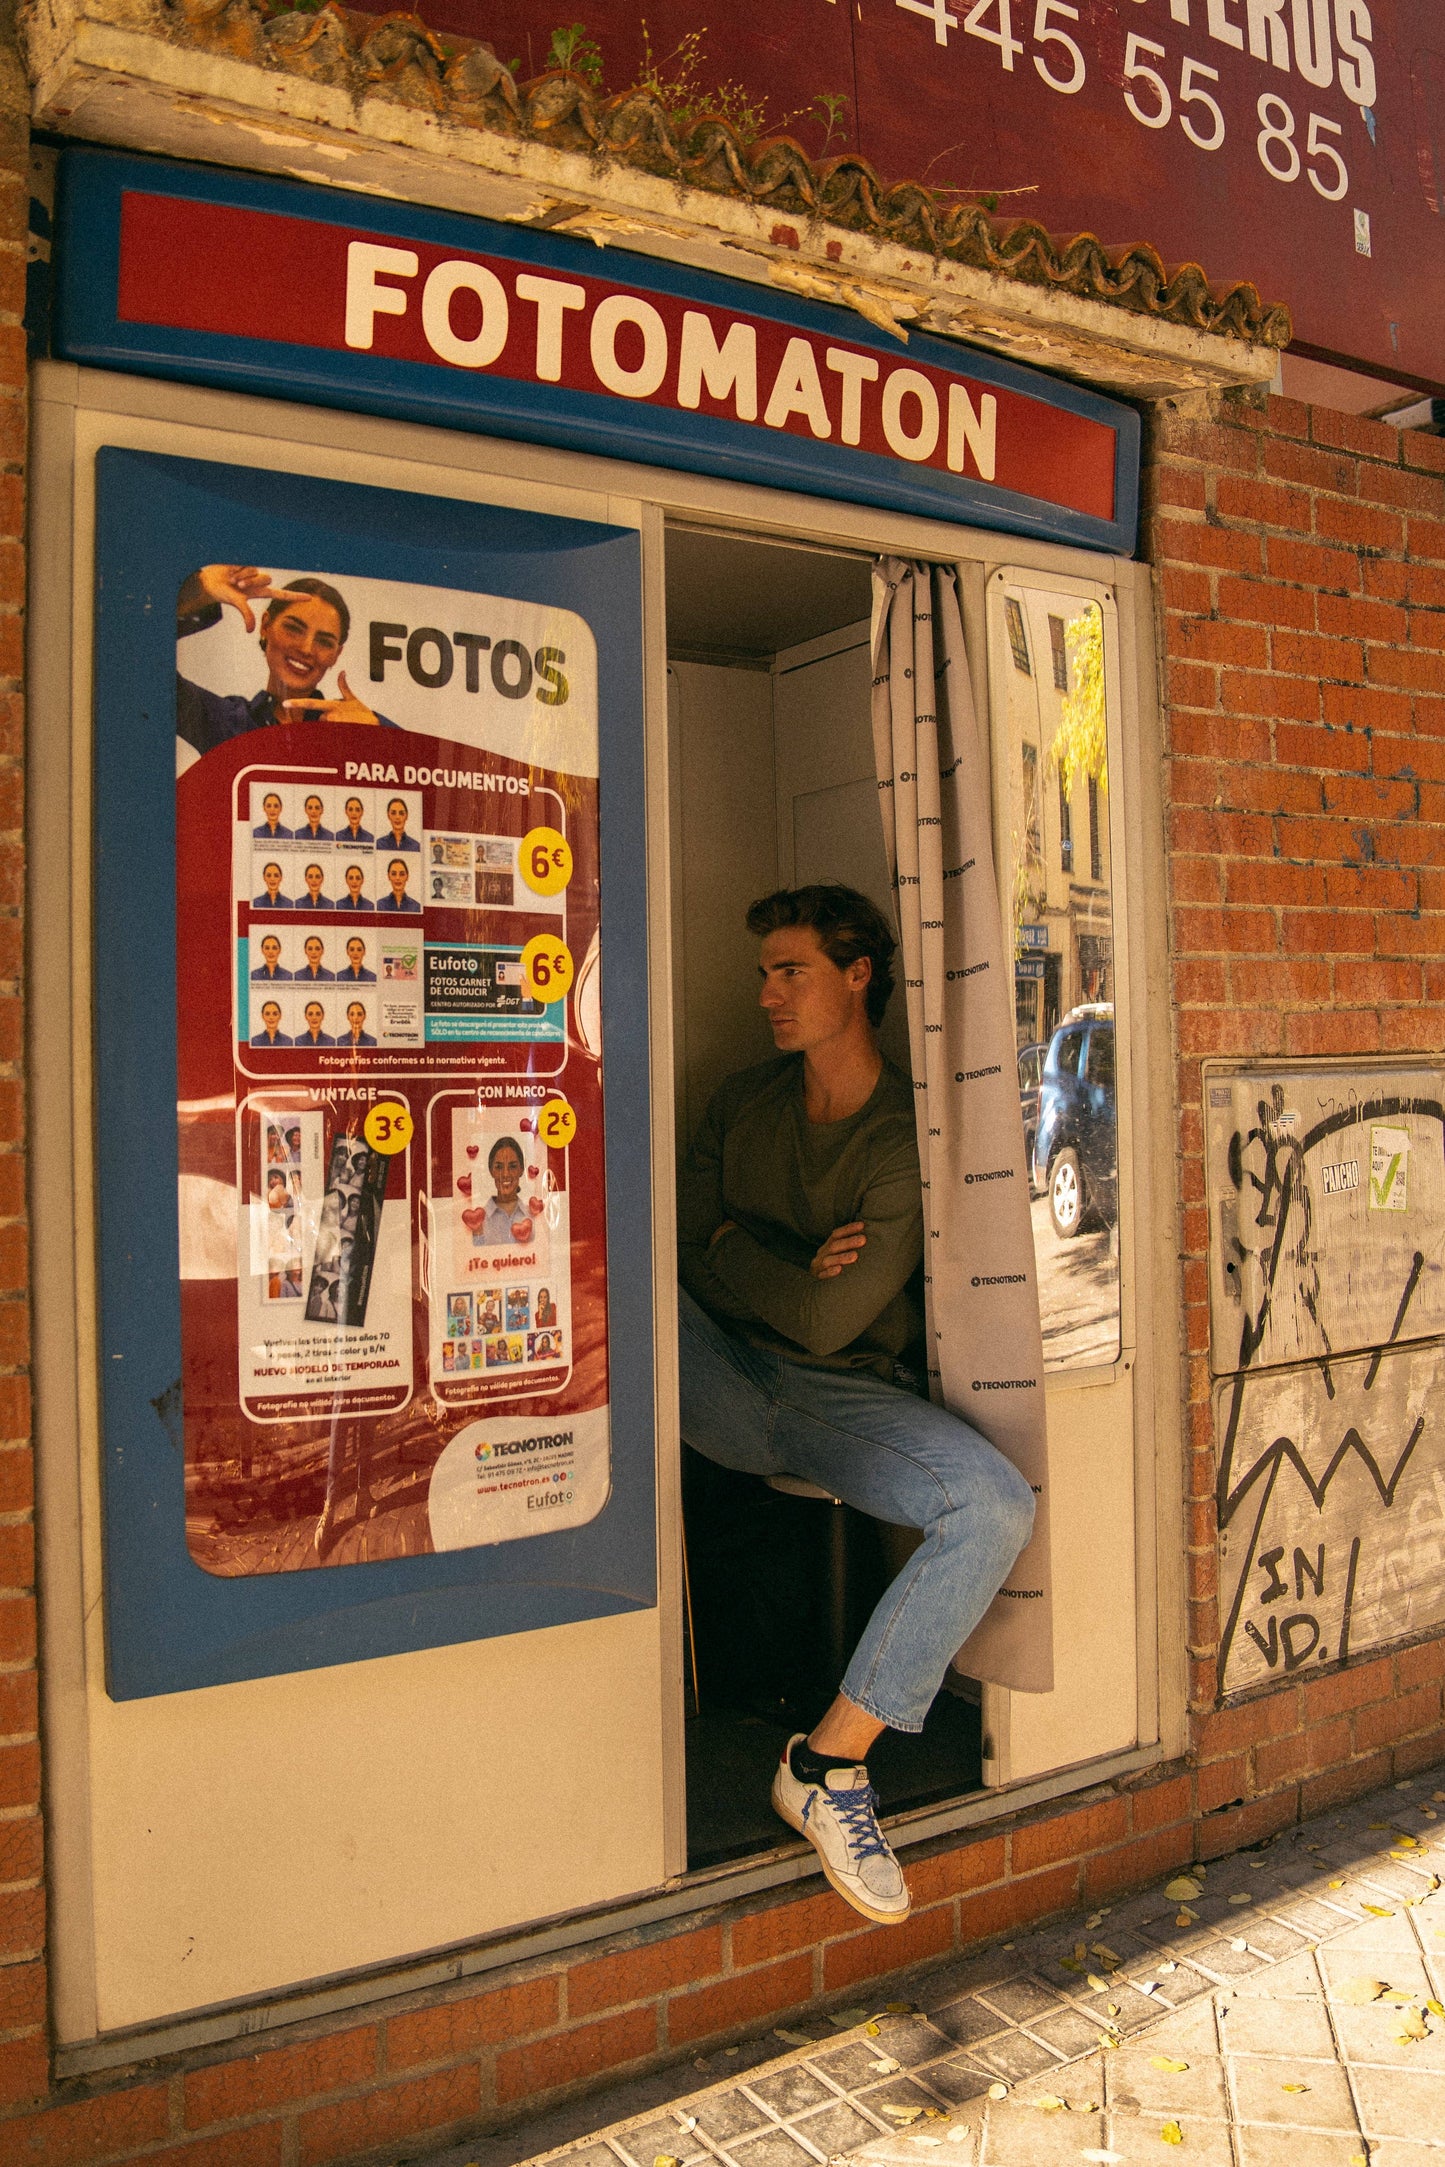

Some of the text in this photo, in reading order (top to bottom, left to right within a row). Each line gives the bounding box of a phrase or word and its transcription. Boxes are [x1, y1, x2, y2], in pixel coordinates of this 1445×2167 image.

[1123, 31, 1225, 151] 55
[1257, 92, 1348, 201] 85
[345, 241, 997, 482] FOTOMATON
[369, 621, 570, 706] FOTOS
[345, 761, 530, 796] PARA DOCUMENTOS
[531, 845, 564, 878] 6€
[430, 956, 478, 972] Eufoto
[532, 953, 565, 986] 6€
[956, 961, 989, 979] TECNOTRON
[430, 977, 491, 987] FOTOS CARNET
[430, 986, 488, 996] DE CONDUCIR
[319, 1056, 371, 1067] Fotografías
[373, 1056, 418, 1064] conformes
[427, 1056, 434, 1064] la
[436, 1056, 476, 1064] normativa
[478, 1056, 507, 1066] vigente.
[965, 1065, 1001, 1080] TECNOTRON
[309, 1087, 377, 1101] VINTAGE
[477, 1085, 546, 1098] CON MARCO
[375, 1116, 405, 1141] 3€
[547, 1112, 570, 1135] 2€
[975, 1169, 1014, 1182] TECNOTRON
[1323, 1162, 1359, 1193] PANCHO
[469, 1253, 536, 1271] ¡Te quiero!
[981, 1274, 1026, 1285] TECNOTRON
[380, 1332, 390, 1340] 70
[254, 1367, 287, 1376] NUEVO
[332, 1364, 343, 1372] DE
[346, 1359, 400, 1371] TEMPORADA
[982, 1379, 1036, 1389] TECNOTRON
[492, 1431, 573, 1456] TECNOTRON
[477, 1476, 550, 1494] www.tecnotron.es
[527, 1490, 574, 1509] Eufoto
[1259, 1543, 1325, 1604] IN
